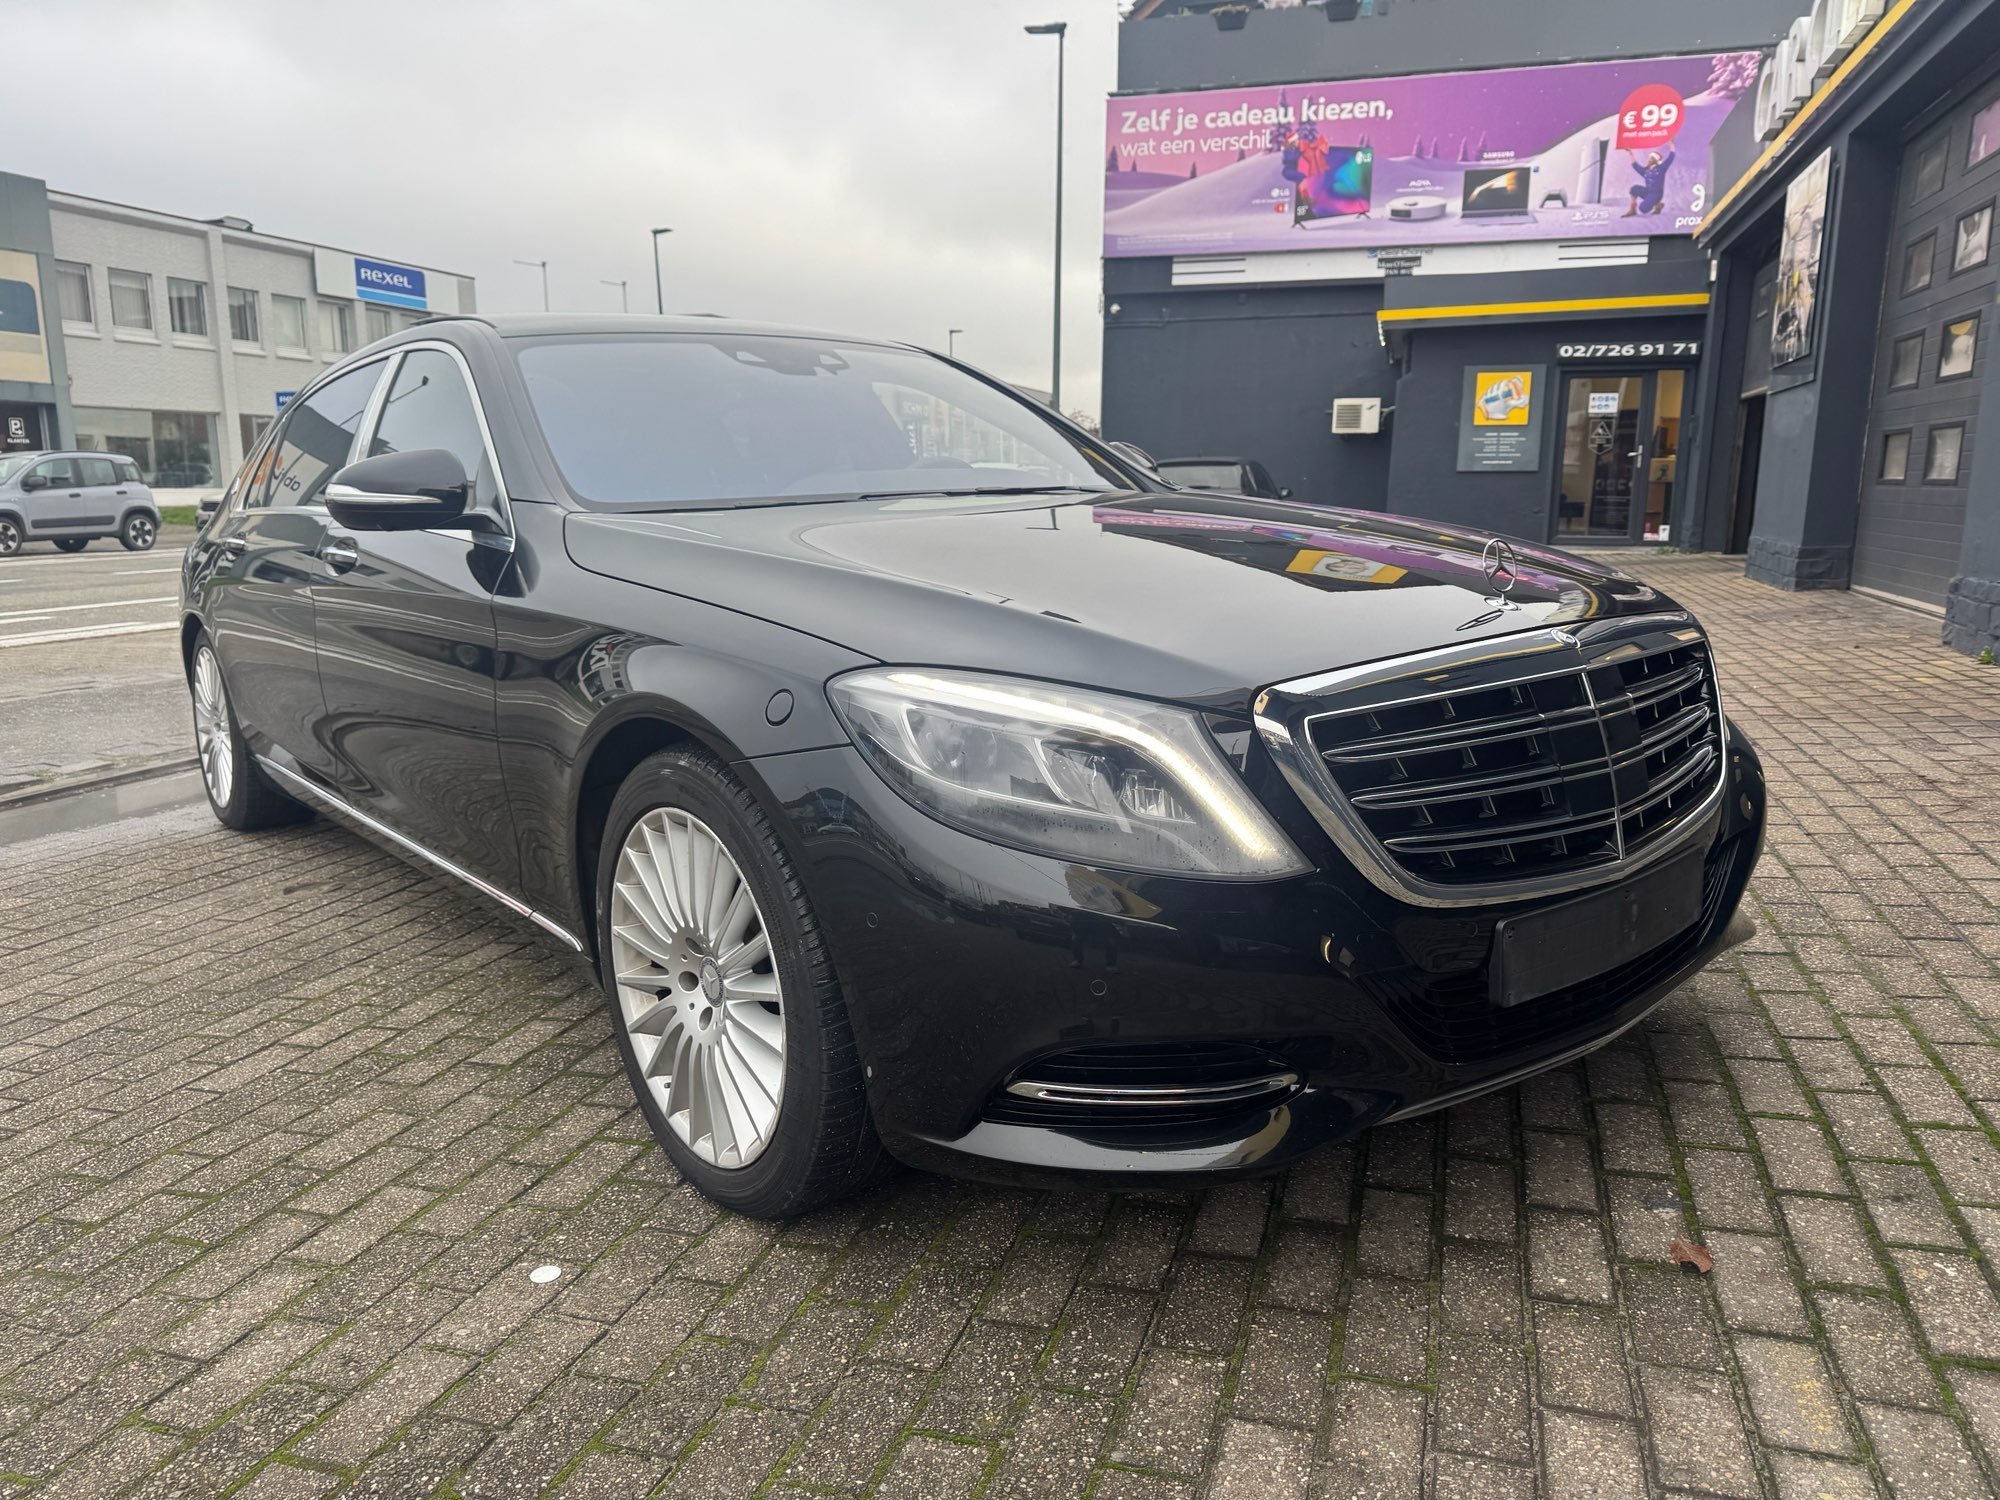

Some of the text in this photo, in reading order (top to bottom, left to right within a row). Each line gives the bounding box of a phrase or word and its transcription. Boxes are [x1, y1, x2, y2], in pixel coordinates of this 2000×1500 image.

[1121, 97, 1393, 135] Zelf je cadeau kiezen,
[1623, 103, 1679, 129] € 99
[1121, 137, 1155, 157] wat
[1160, 137, 1195, 154] een
[1560, 342, 1698, 358] 02/726 91 71
